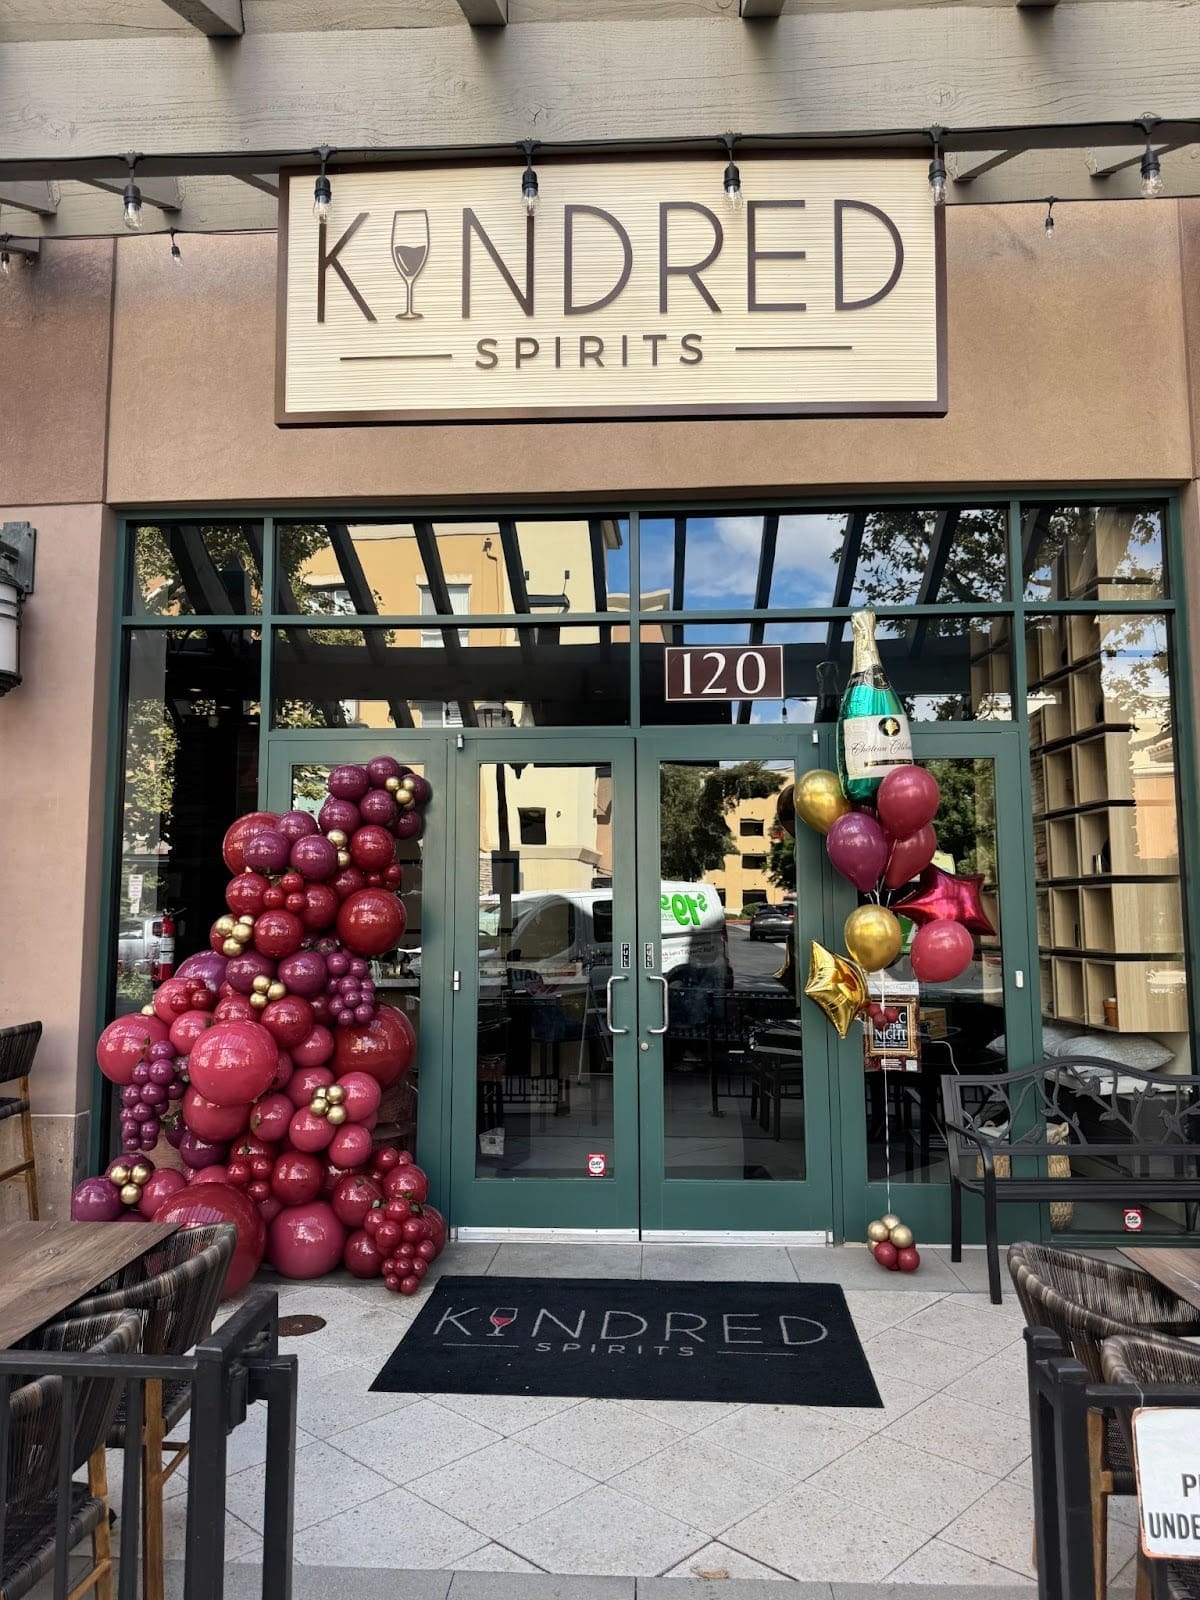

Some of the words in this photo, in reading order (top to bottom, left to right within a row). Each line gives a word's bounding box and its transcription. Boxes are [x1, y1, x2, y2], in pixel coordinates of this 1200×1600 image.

[475, 333, 704, 369] SPIRITS
[682, 651, 767, 695] 120
[874, 1029, 907, 1040] NIGHT
[535, 1342, 695, 1357] SPIRITS
[1181, 1473, 1200, 1498] P
